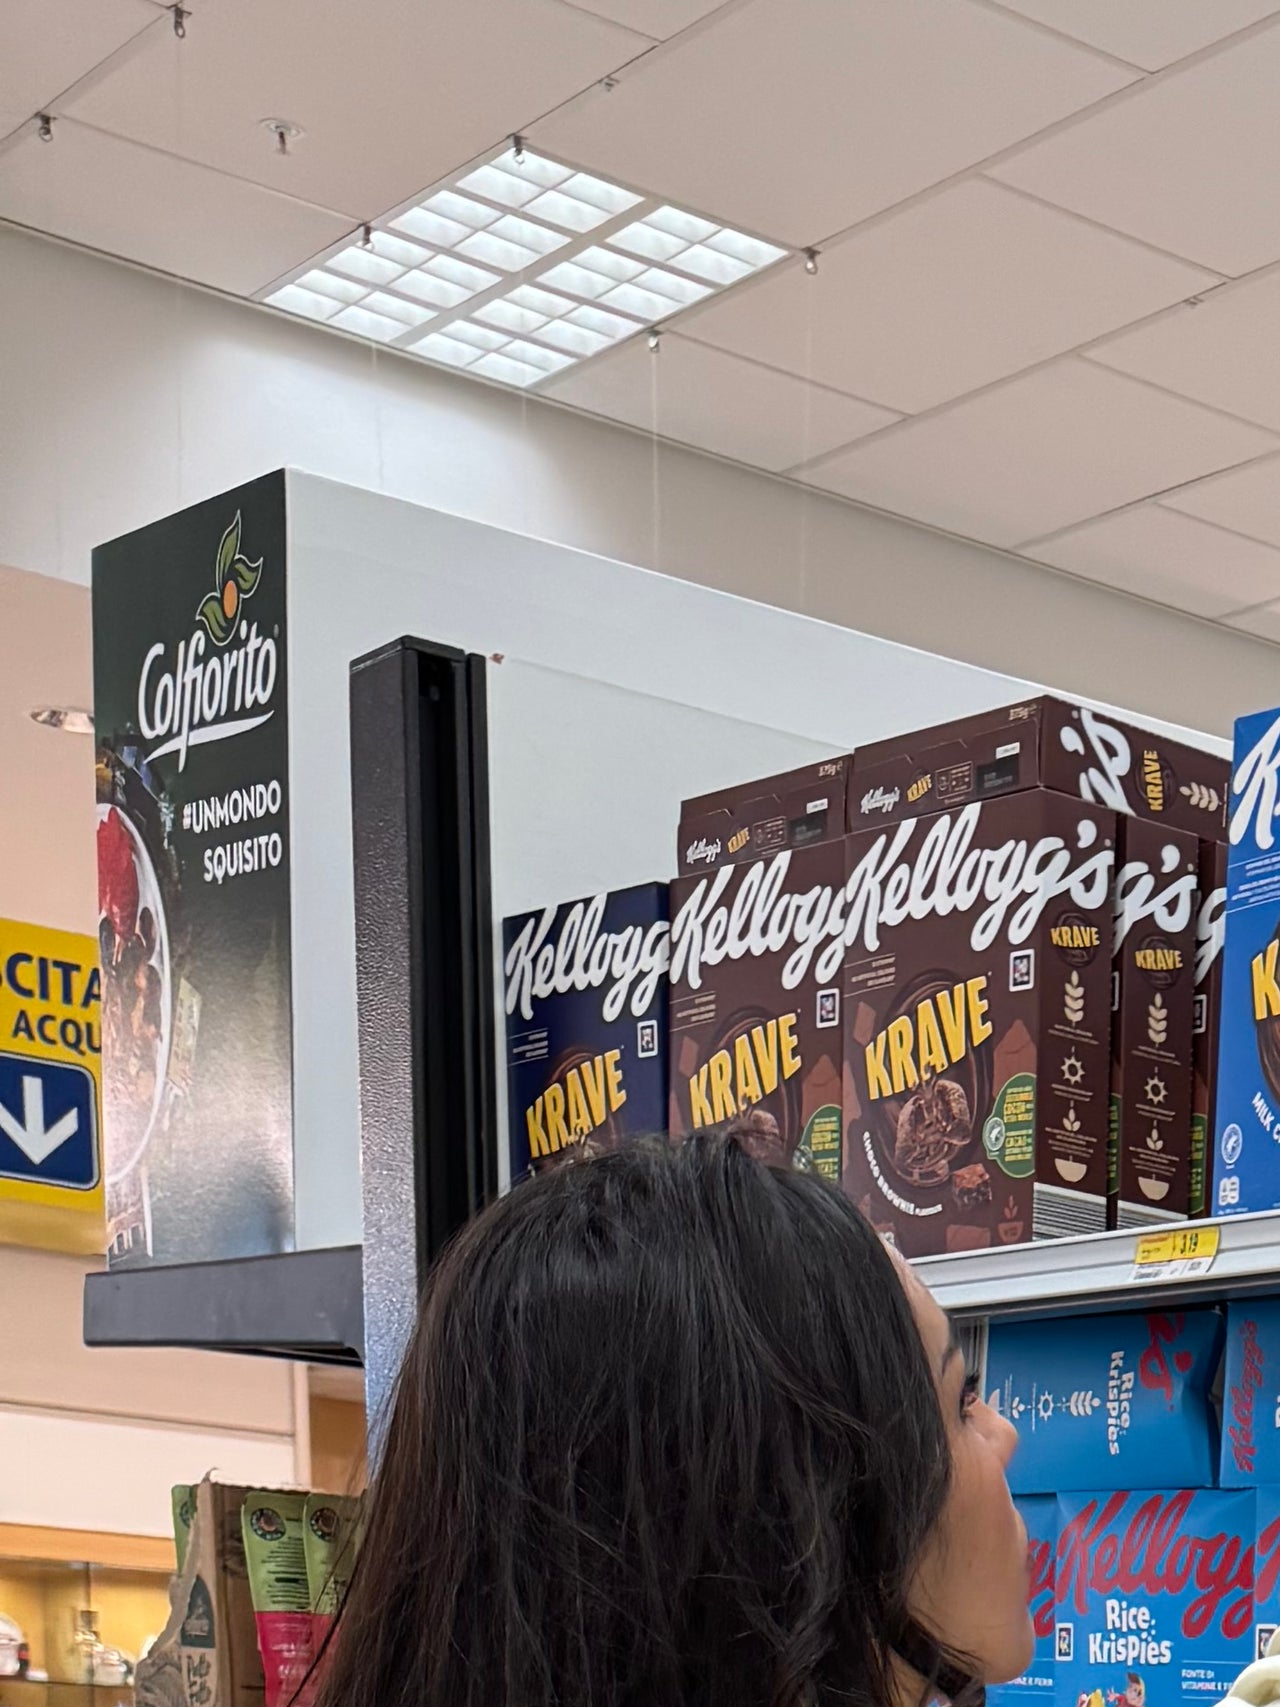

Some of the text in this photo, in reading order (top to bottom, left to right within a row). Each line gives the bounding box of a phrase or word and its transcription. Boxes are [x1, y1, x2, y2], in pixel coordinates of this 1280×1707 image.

[138, 619, 276, 772] Colfiorito
[181, 779, 281, 833] #UNMONDO
[203, 830, 283, 886] SQUISITO
[864, 975, 993, 1101] KRAVE
[525, 1049, 627, 1158] KRAVE
[1252, 1092, 1271, 1132] MILK
[1106, 1599, 1151, 1631] Rice
[1088, 1632, 1171, 1665] Krispies
